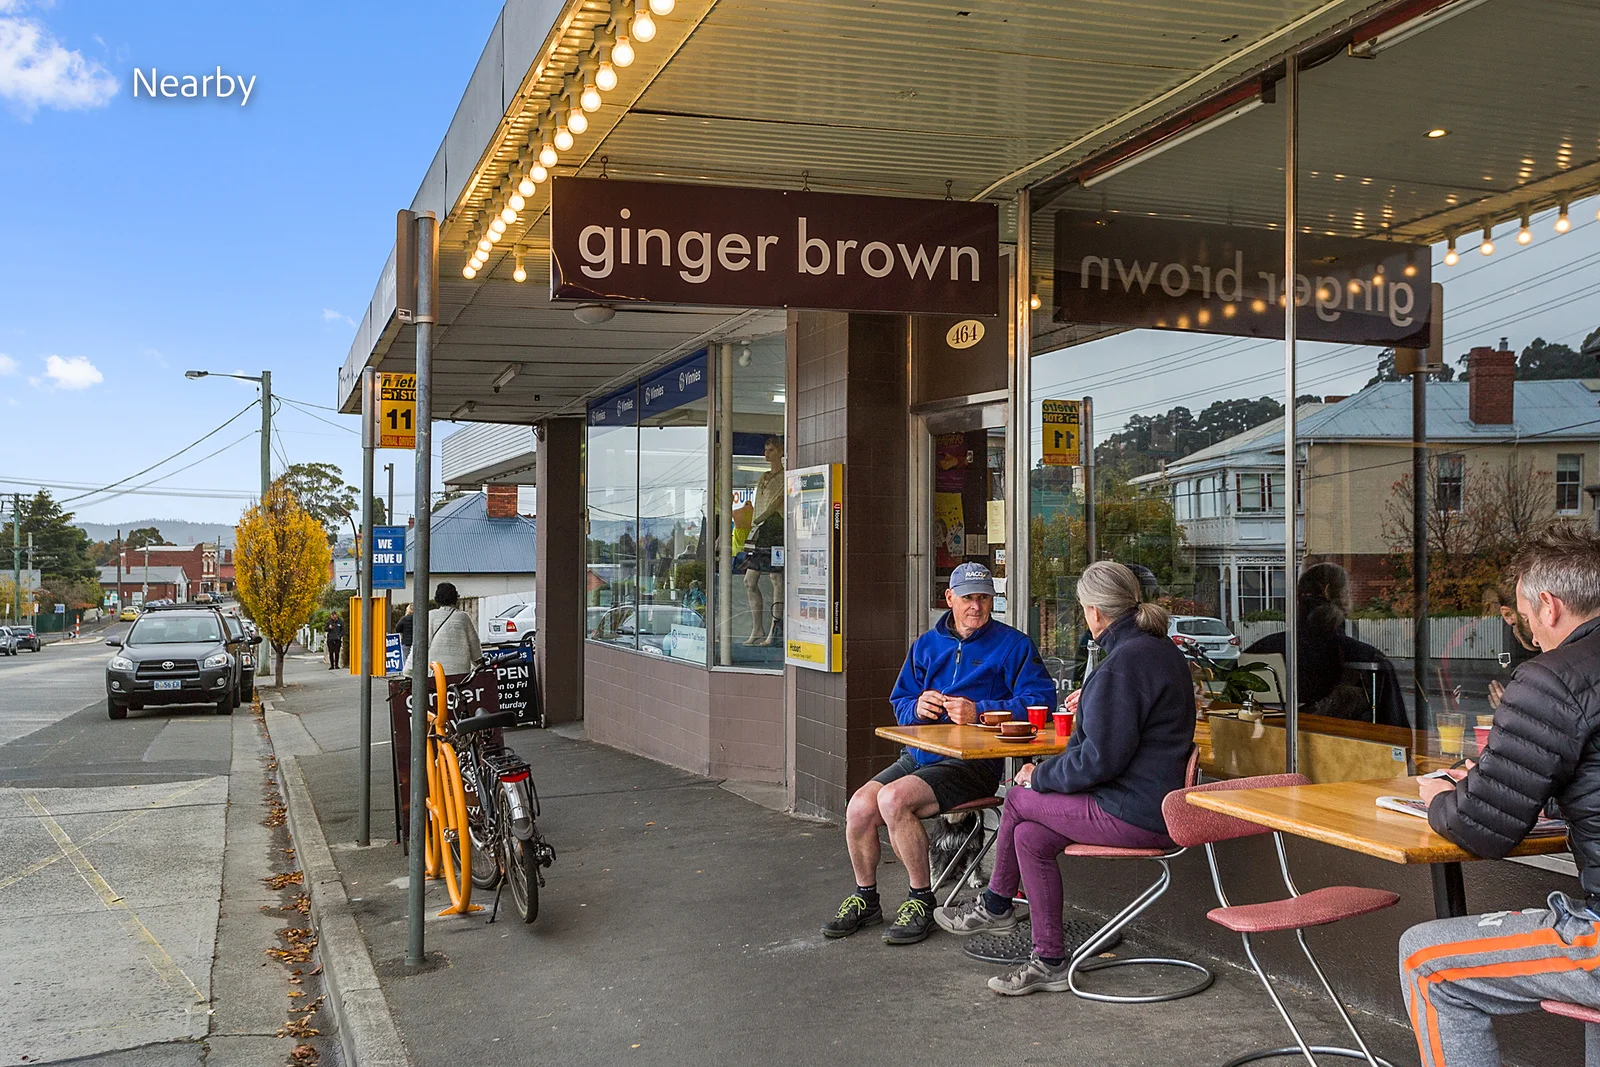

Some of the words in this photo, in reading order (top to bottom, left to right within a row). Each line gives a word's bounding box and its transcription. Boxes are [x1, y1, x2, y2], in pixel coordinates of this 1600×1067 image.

[578, 207, 779, 284] ginger
[798, 216, 980, 282] brown
[951, 323, 977, 345] 464
[685, 369, 701, 386] Vinnies
[650, 384, 664, 400] Vinnies
[621, 399, 634, 412] Vinnies
[386, 408, 412, 430] 11
[377, 538, 393, 549] WE
[372, 553, 395, 564] ERVE
[396, 553, 403, 564] U
[386, 658, 400, 669] uty
[496, 665, 529, 680] PEN
[516, 681, 528, 689] Fri
[515, 690, 520, 698] 5
